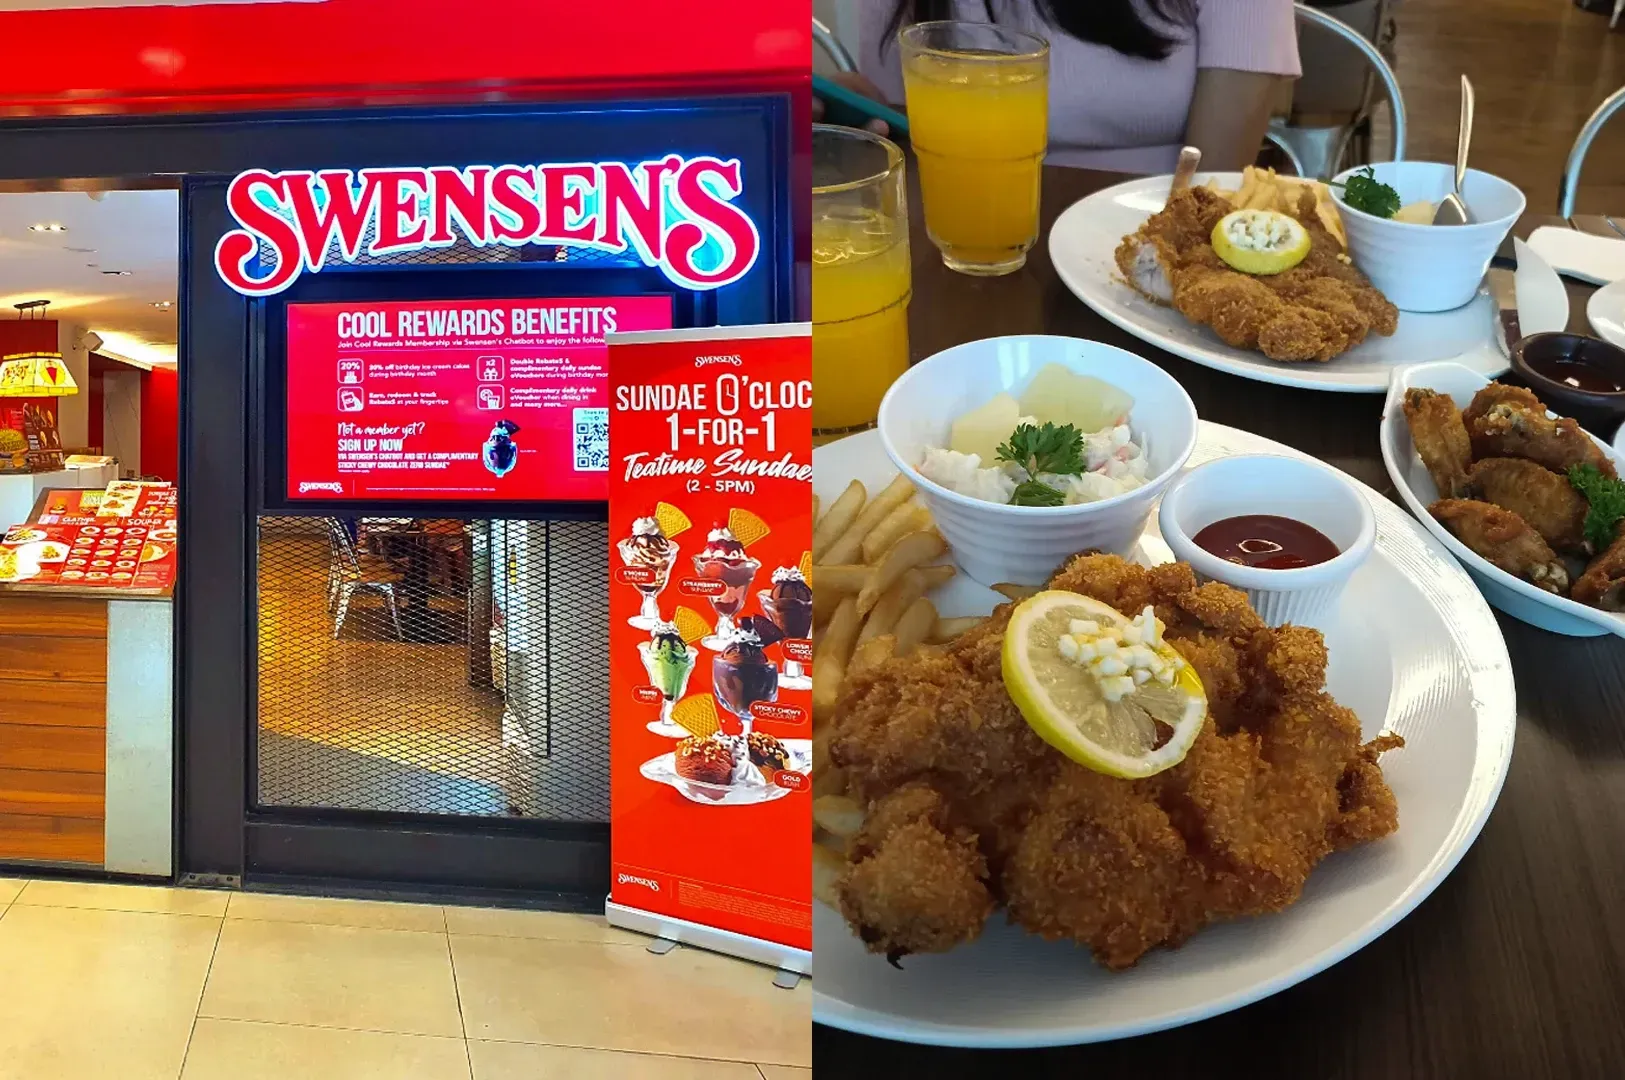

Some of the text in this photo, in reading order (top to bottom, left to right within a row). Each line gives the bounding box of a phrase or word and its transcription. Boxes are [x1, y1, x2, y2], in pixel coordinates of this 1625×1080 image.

[214, 154, 760, 297] SWENSEN'S
[337, 306, 617, 338] COOL REWARDS BENEFITS
[338, 340, 352, 348] Join
[354, 340, 371, 348] Cool
[405, 340, 450, 348] Membership
[464, 338, 502, 346] Swensen's
[546, 338, 566, 346] enjoy
[341, 362, 360, 370] 20%
[395, 364, 420, 372] birthday
[560, 364, 578, 372] daily
[694, 354, 743, 368] SWENSEN'S
[568, 371, 594, 379] birthday
[510, 387, 560, 395] Complimentary
[616, 383, 707, 411] SUNDAE
[338, 422, 356, 436] Not
[364, 423, 400, 436] member
[402, 421, 426, 440] yet?
[666, 411, 776, 452] 1-FOR-1
[338, 438, 403, 452] SIGN UP NOW
[404, 452, 416, 460] AND
[416, 452, 426, 460] GET
[623, 451, 707, 483] Teatime
[686, 479, 700, 494] (2
[715, 479, 756, 495] 5PM)
[778, 708, 801, 716] CHEWY
[782, 774, 801, 782] GOLD
[618, 873, 660, 892] SWENSEN'S
